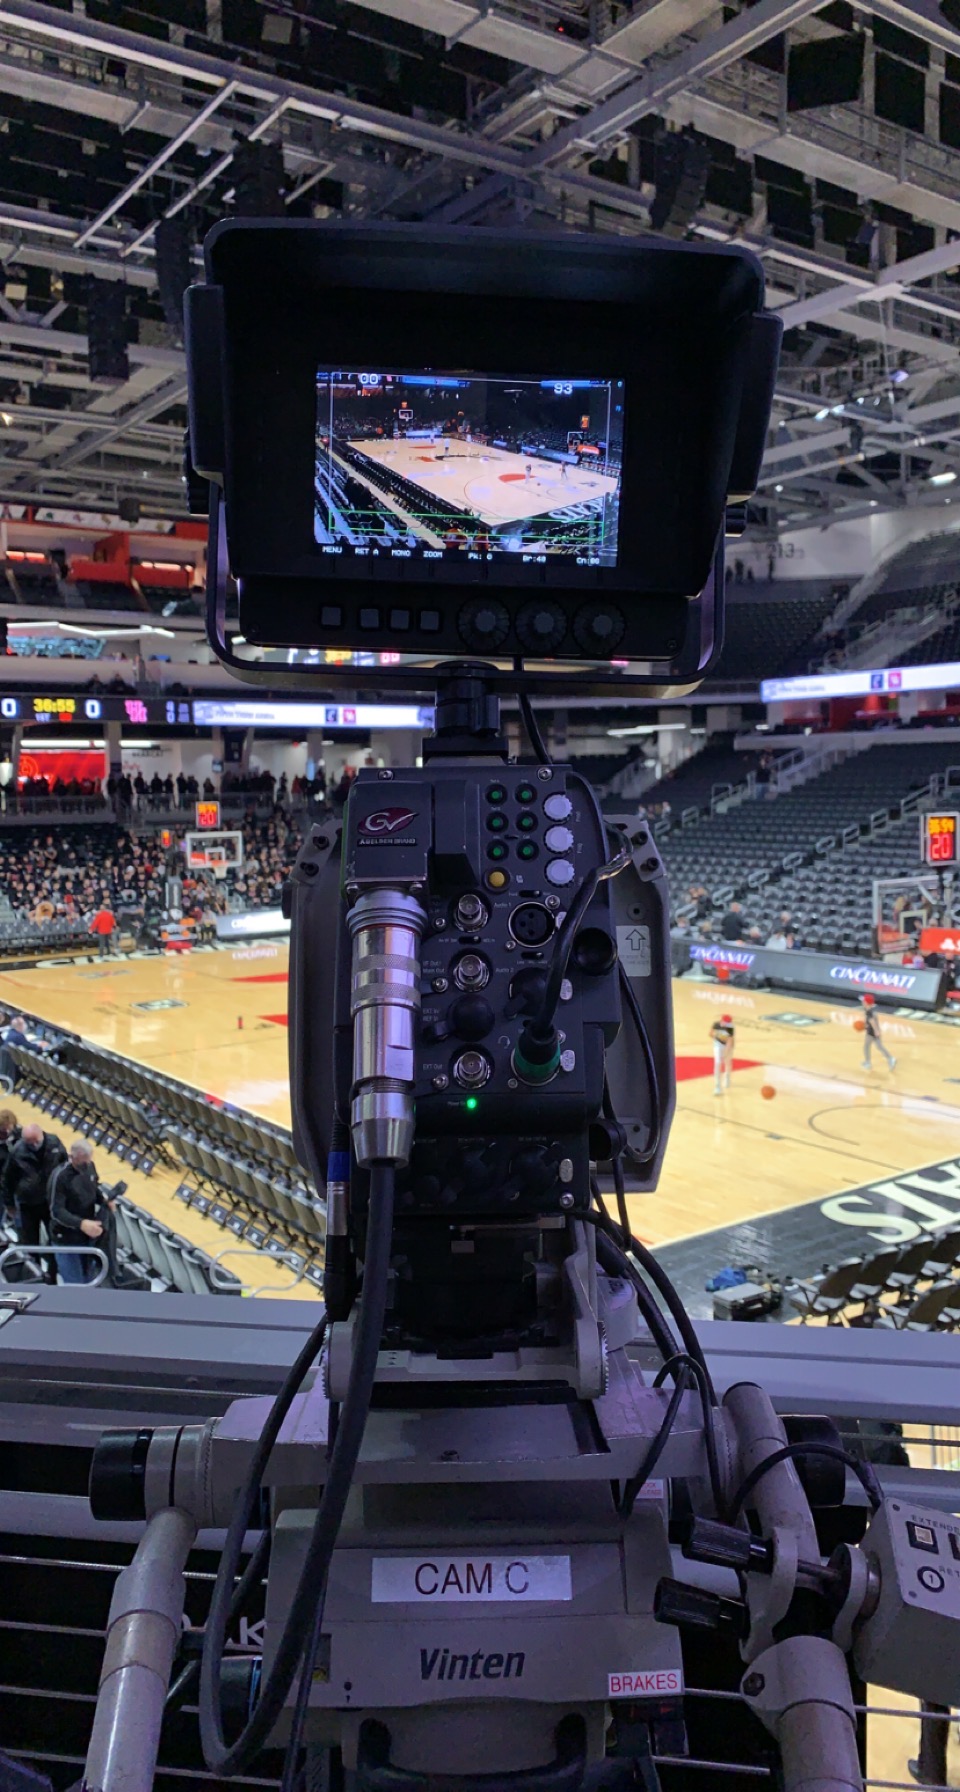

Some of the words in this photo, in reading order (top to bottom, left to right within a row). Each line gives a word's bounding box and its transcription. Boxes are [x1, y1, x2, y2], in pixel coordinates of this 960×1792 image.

[360, 373, 378, 384] 00
[554, 383, 573, 394] 93
[372, 548, 379, 556] A
[86, 699, 101, 718] 0
[200, 813, 215, 826] 20
[932, 834, 953, 859] 20
[830, 965, 916, 989] CINCINNATI
[415, 1563, 492, 1595] CAM
[505, 1562, 529, 1594] C
[420, 1648, 525, 1680] Vinten
[610, 1673, 678, 1692] BRAKES
